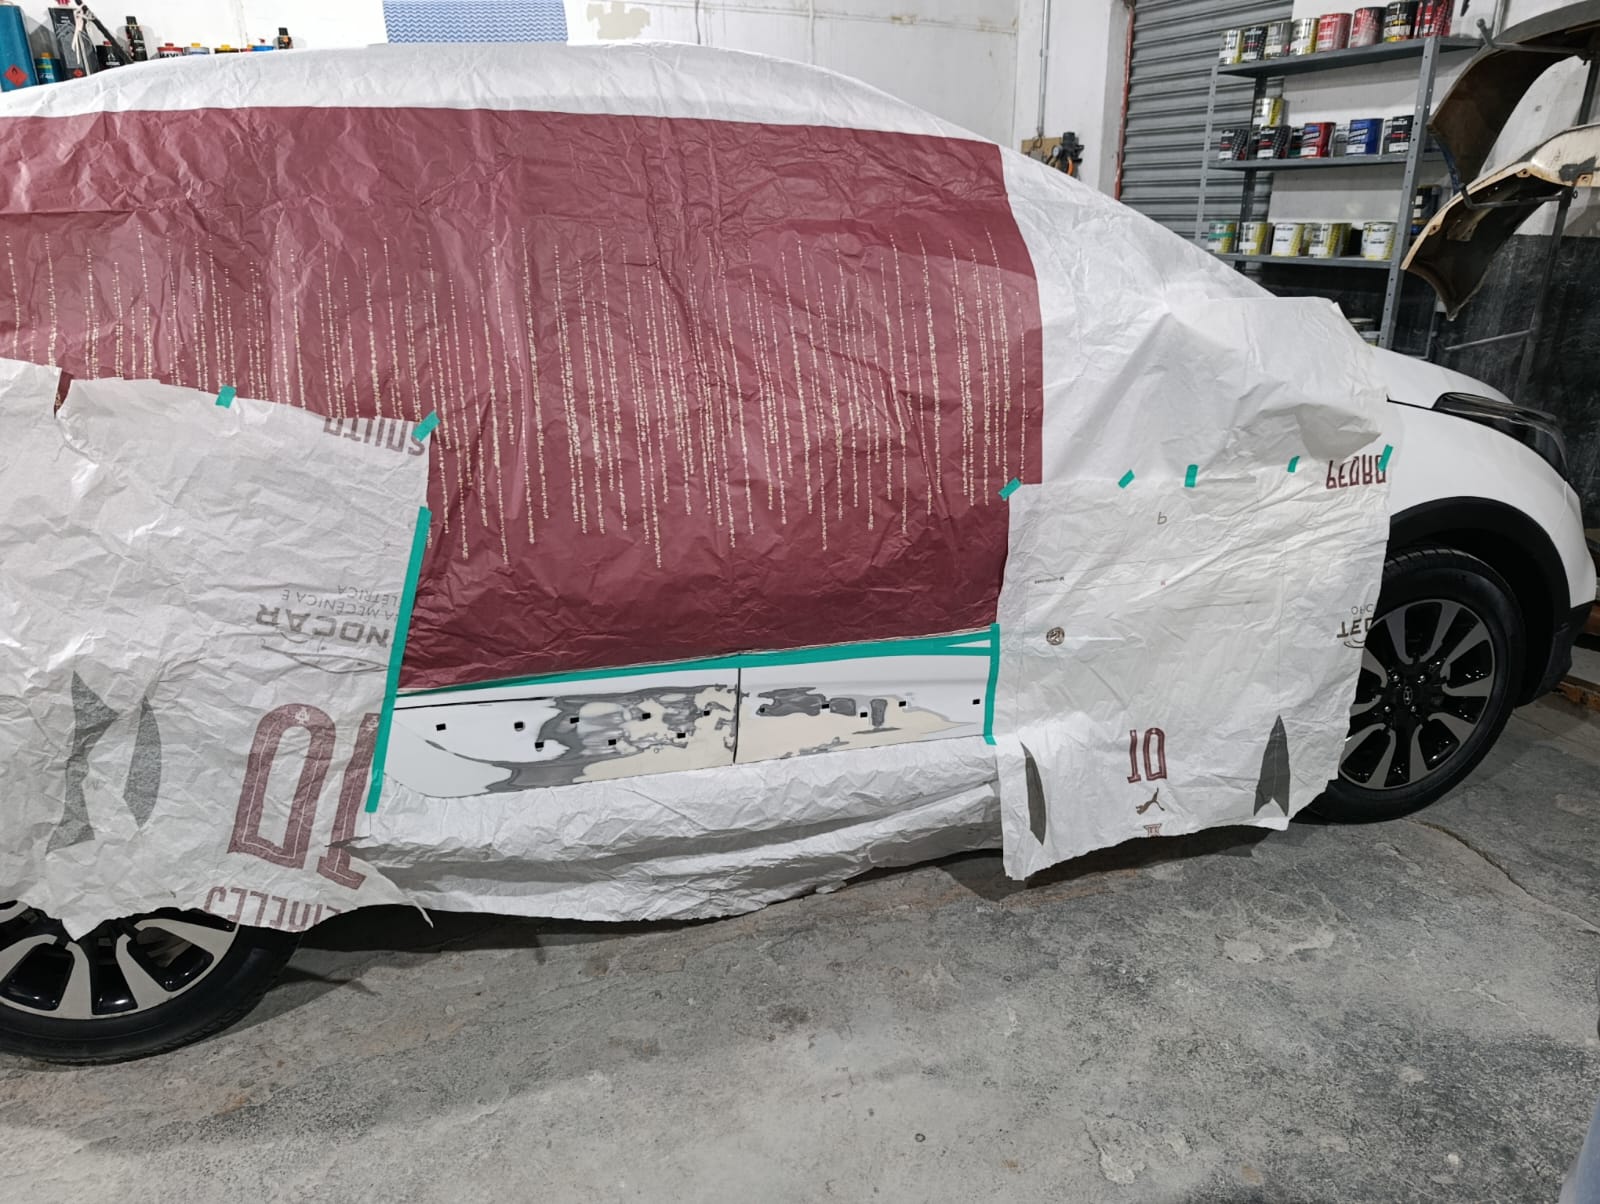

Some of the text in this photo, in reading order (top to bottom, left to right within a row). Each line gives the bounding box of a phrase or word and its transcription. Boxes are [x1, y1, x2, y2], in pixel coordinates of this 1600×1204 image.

[280, 589, 290, 601] E
[255, 604, 391, 649] NOCAR
[227, 703, 379, 890] 10
